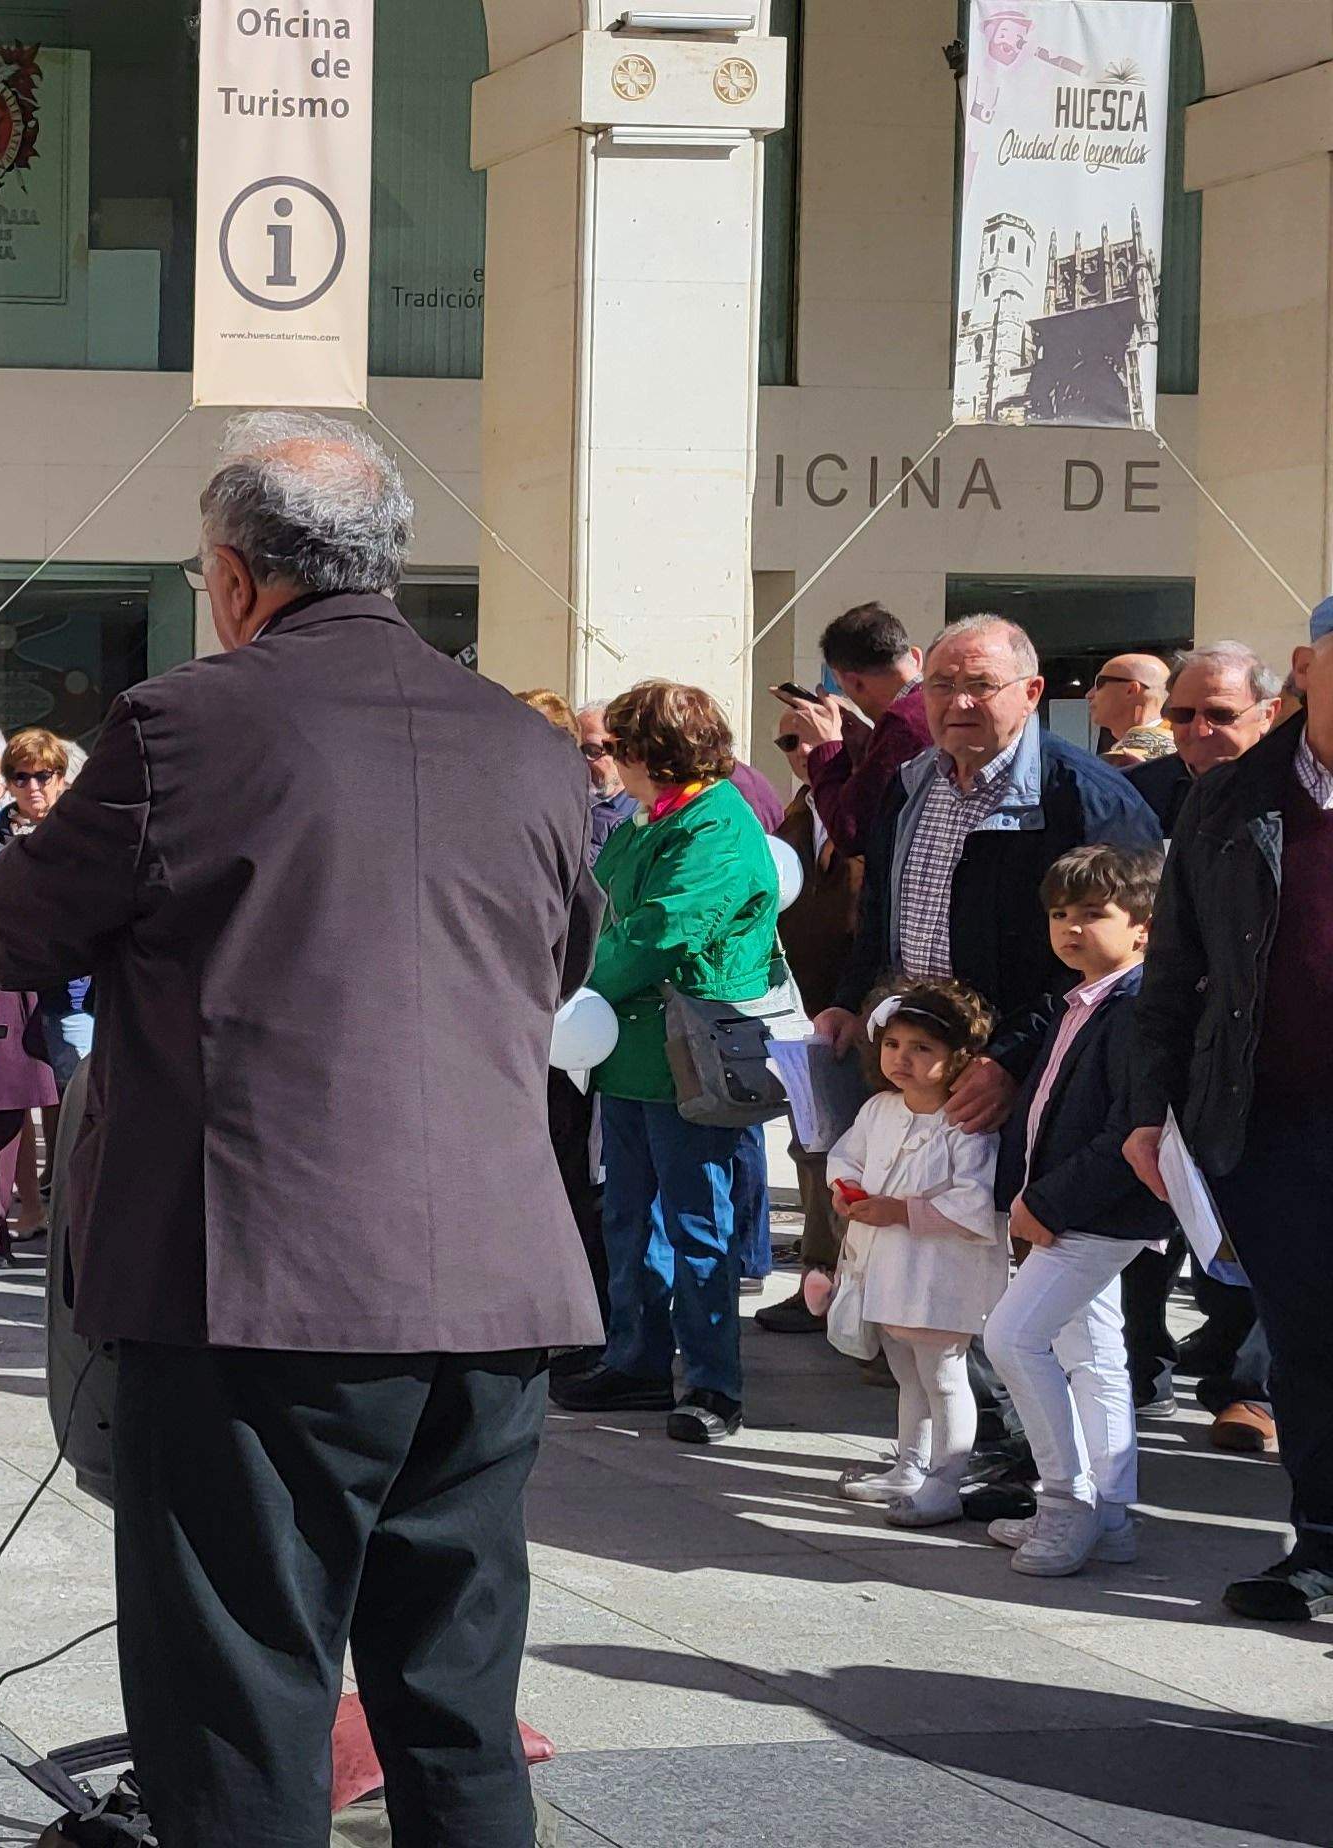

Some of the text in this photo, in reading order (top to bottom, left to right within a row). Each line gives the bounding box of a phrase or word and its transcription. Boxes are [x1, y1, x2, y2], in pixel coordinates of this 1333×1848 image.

[236, 8, 351, 39] Oficina
[310, 50, 351, 79] de
[217, 87, 350, 118] Turismo
[1055, 86, 1148, 132] HUESCA
[997, 128, 1150, 174] Ciudad de leyendas
[219, 331, 341, 342] www.huescaturismo.com
[774, 454, 1161, 513] ICINA DE
